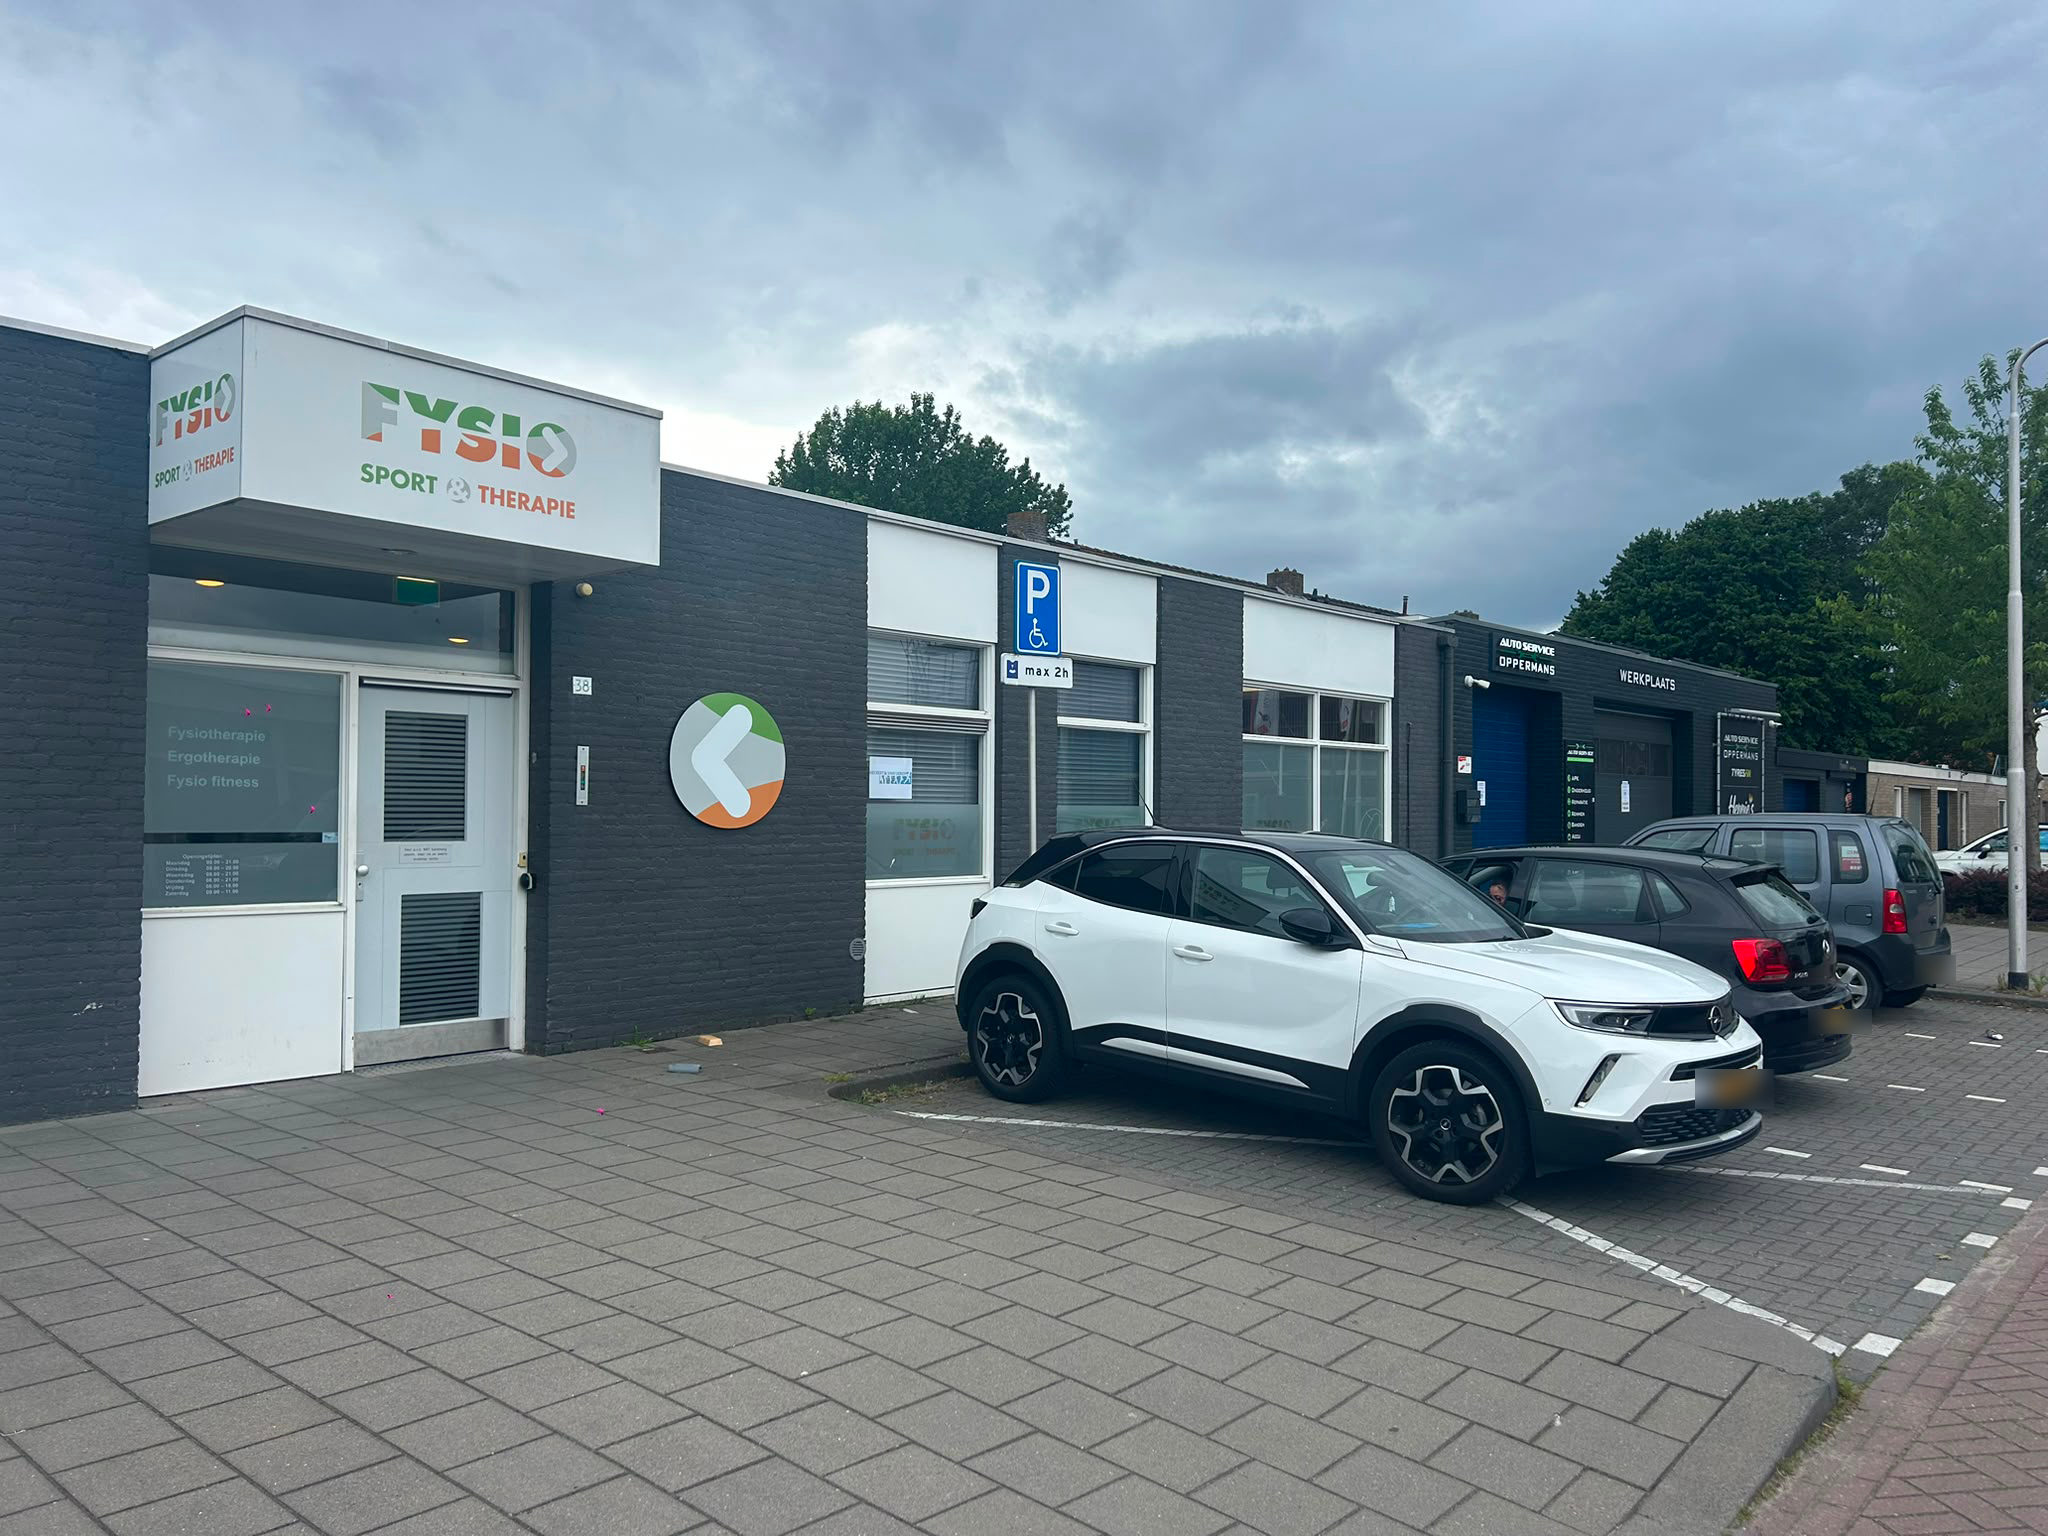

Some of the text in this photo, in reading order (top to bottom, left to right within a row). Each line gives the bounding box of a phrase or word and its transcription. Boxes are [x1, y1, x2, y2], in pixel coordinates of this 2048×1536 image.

[156, 373, 236, 447] FYSIO
[361, 380, 577, 478] FYSIO
[154, 466, 180, 488] SPORT
[194, 447, 235, 474] THERAPIE
[360, 463, 576, 519] SPORT & THERAPIE
[1026, 569, 1051, 615] P
[1500, 637, 1555, 657] AUTO SERVICE
[1025, 666, 1069, 679] max 2h
[1499, 656, 1556, 676] OPPERMANS
[574, 679, 590, 693] 38
[1619, 668, 1676, 692] WERKPLAATS
[168, 726, 266, 743] Fysiotherapie
[1738, 736, 1758, 745] SERVICE
[167, 750, 261, 766] Ergotherapie
[1723, 750, 1758, 760] OPPERMANS
[167, 774, 259, 790] Fysio fitness
